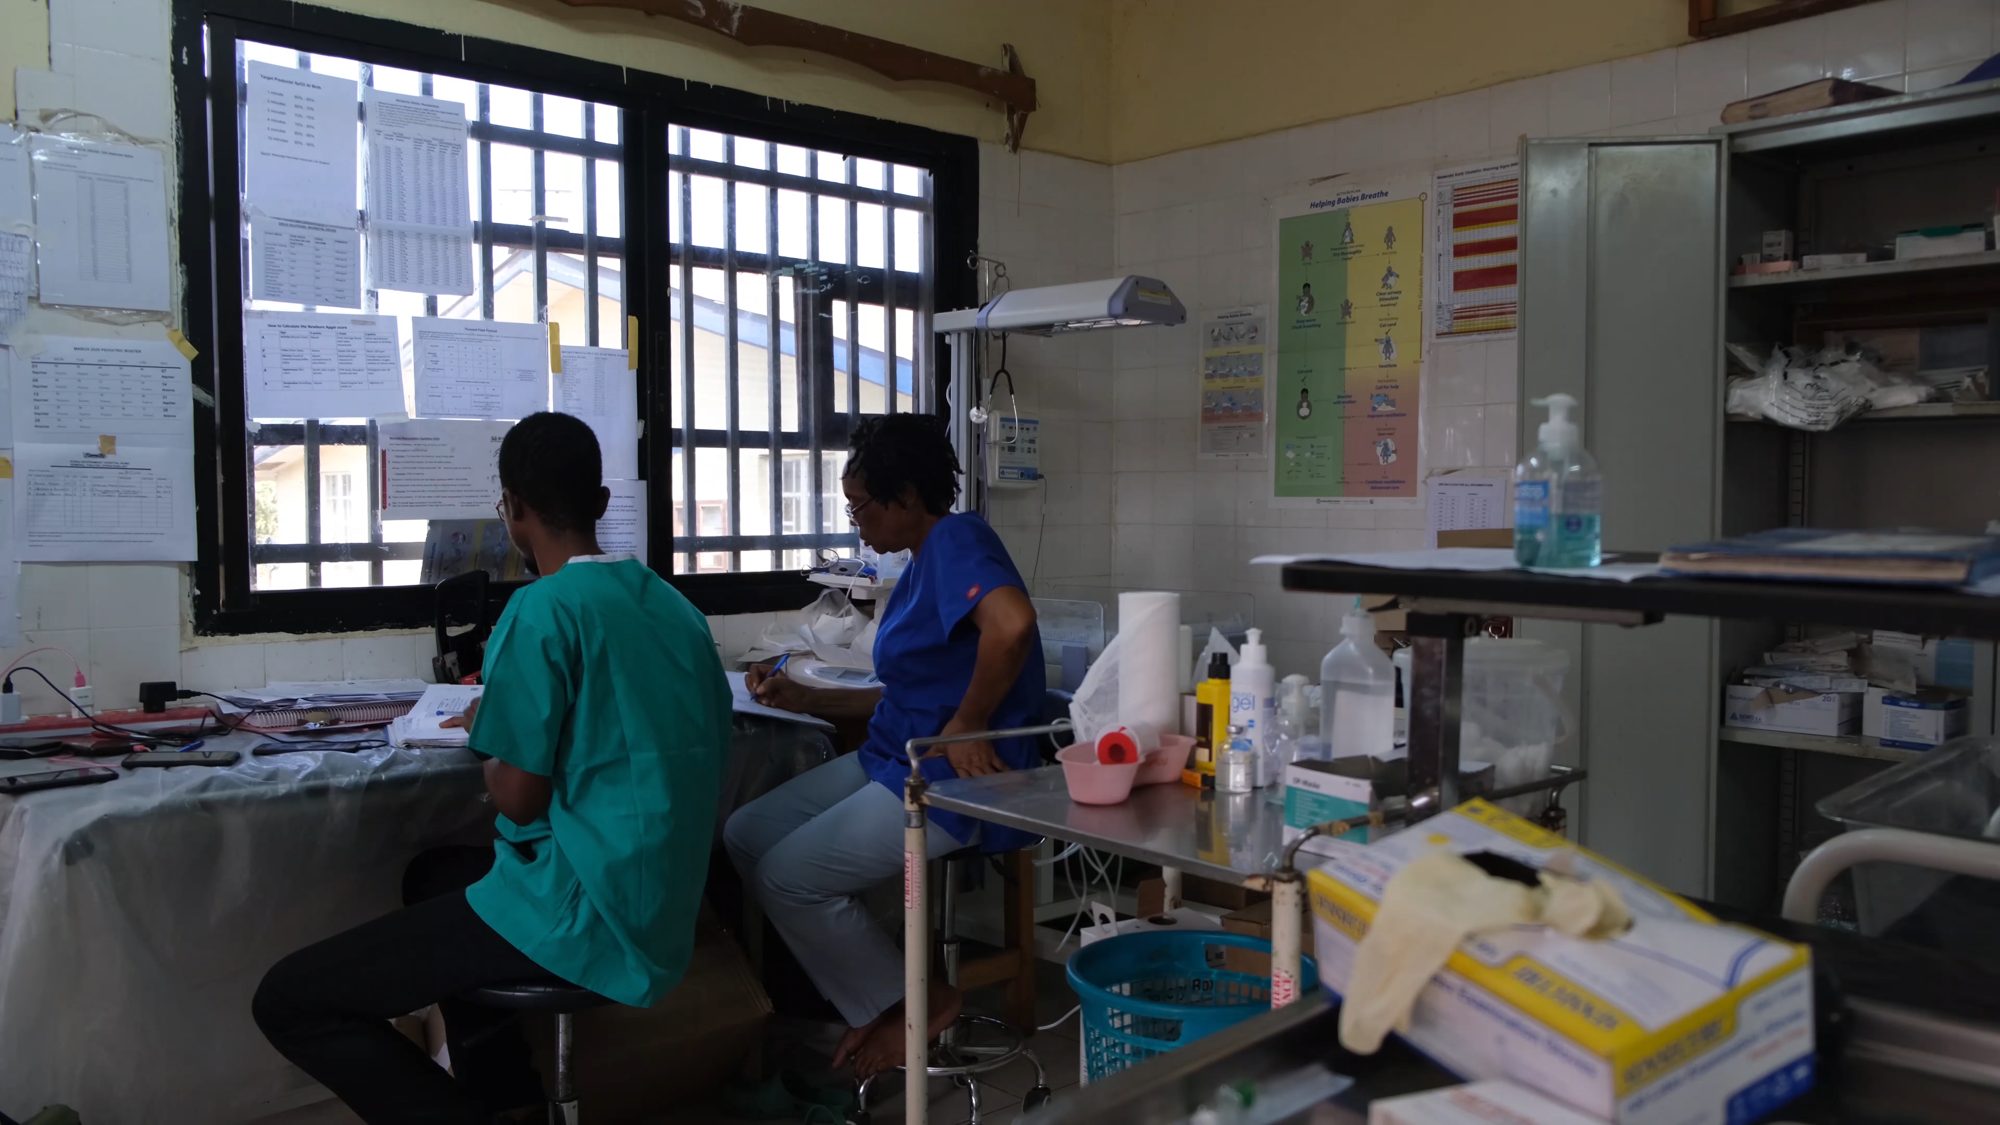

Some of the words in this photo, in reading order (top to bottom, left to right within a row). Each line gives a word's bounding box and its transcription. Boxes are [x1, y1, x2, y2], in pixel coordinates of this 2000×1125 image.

[1310, 199, 1336, 209] Helping
[1336, 194, 1360, 205] Babies
[1360, 190, 1389, 201] Breathe
[1232, 694, 1256, 713] gel
